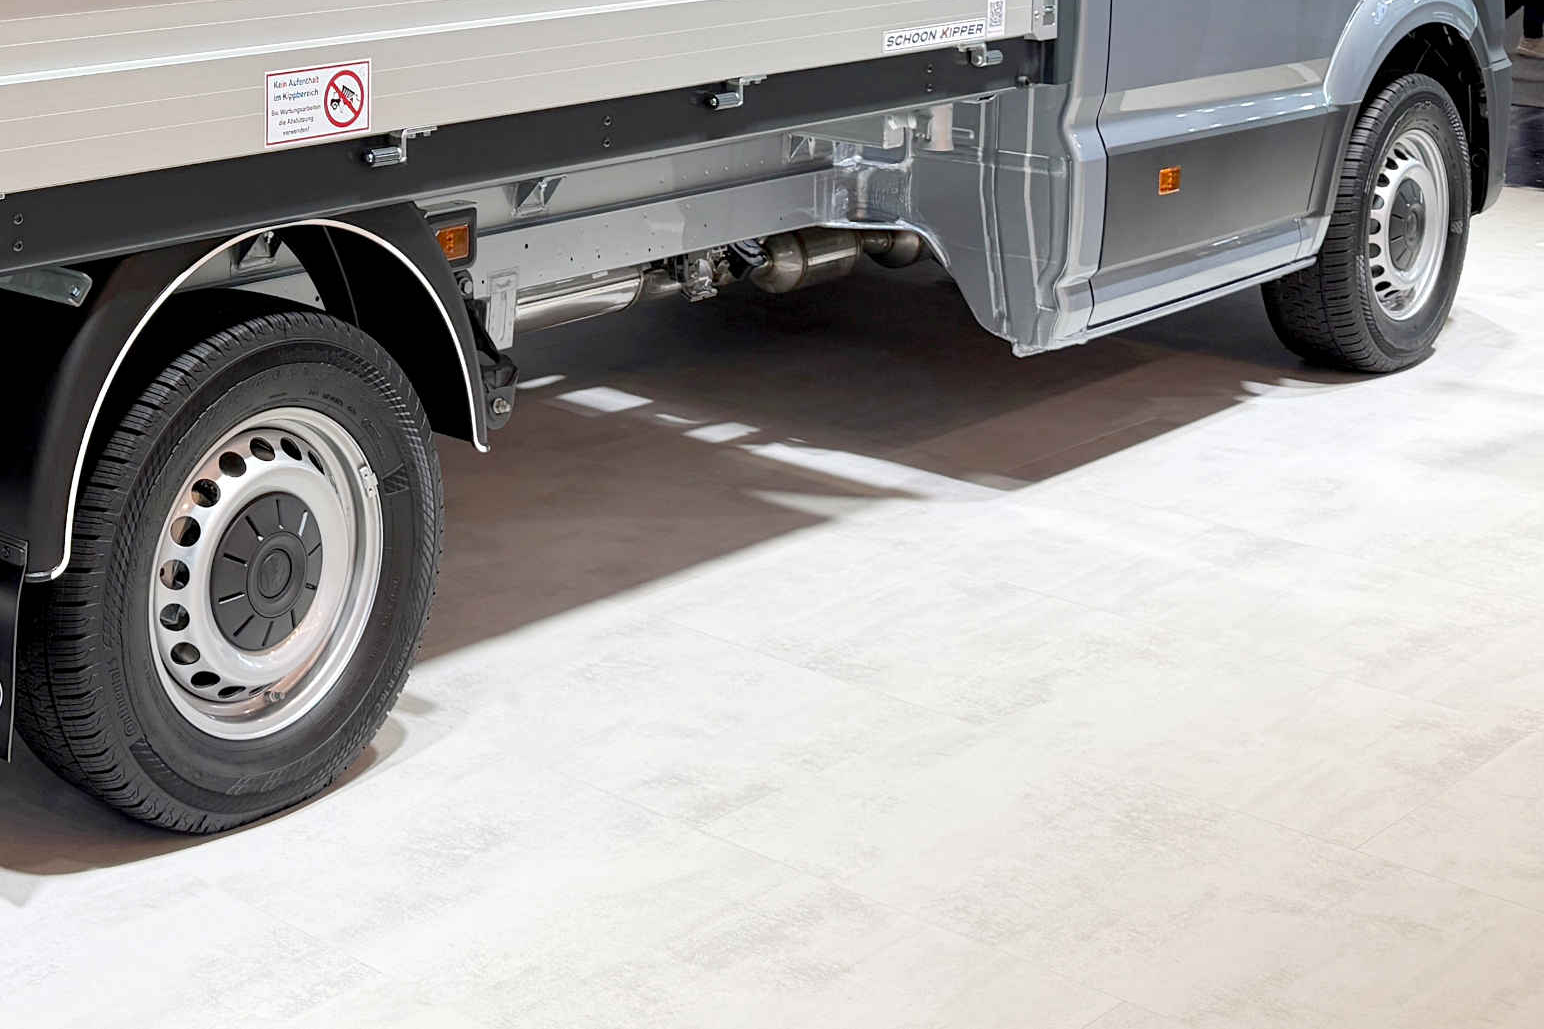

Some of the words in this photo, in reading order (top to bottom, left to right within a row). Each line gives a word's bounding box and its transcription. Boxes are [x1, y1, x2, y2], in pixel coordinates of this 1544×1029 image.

[886, 30, 938, 47] SCHOON
[939, 23, 984, 39] KIPPER
[273, 79, 287, 89] Kein
[288, 76, 319, 87] Aufenthalt
[282, 89, 319, 102] Kippbereich
